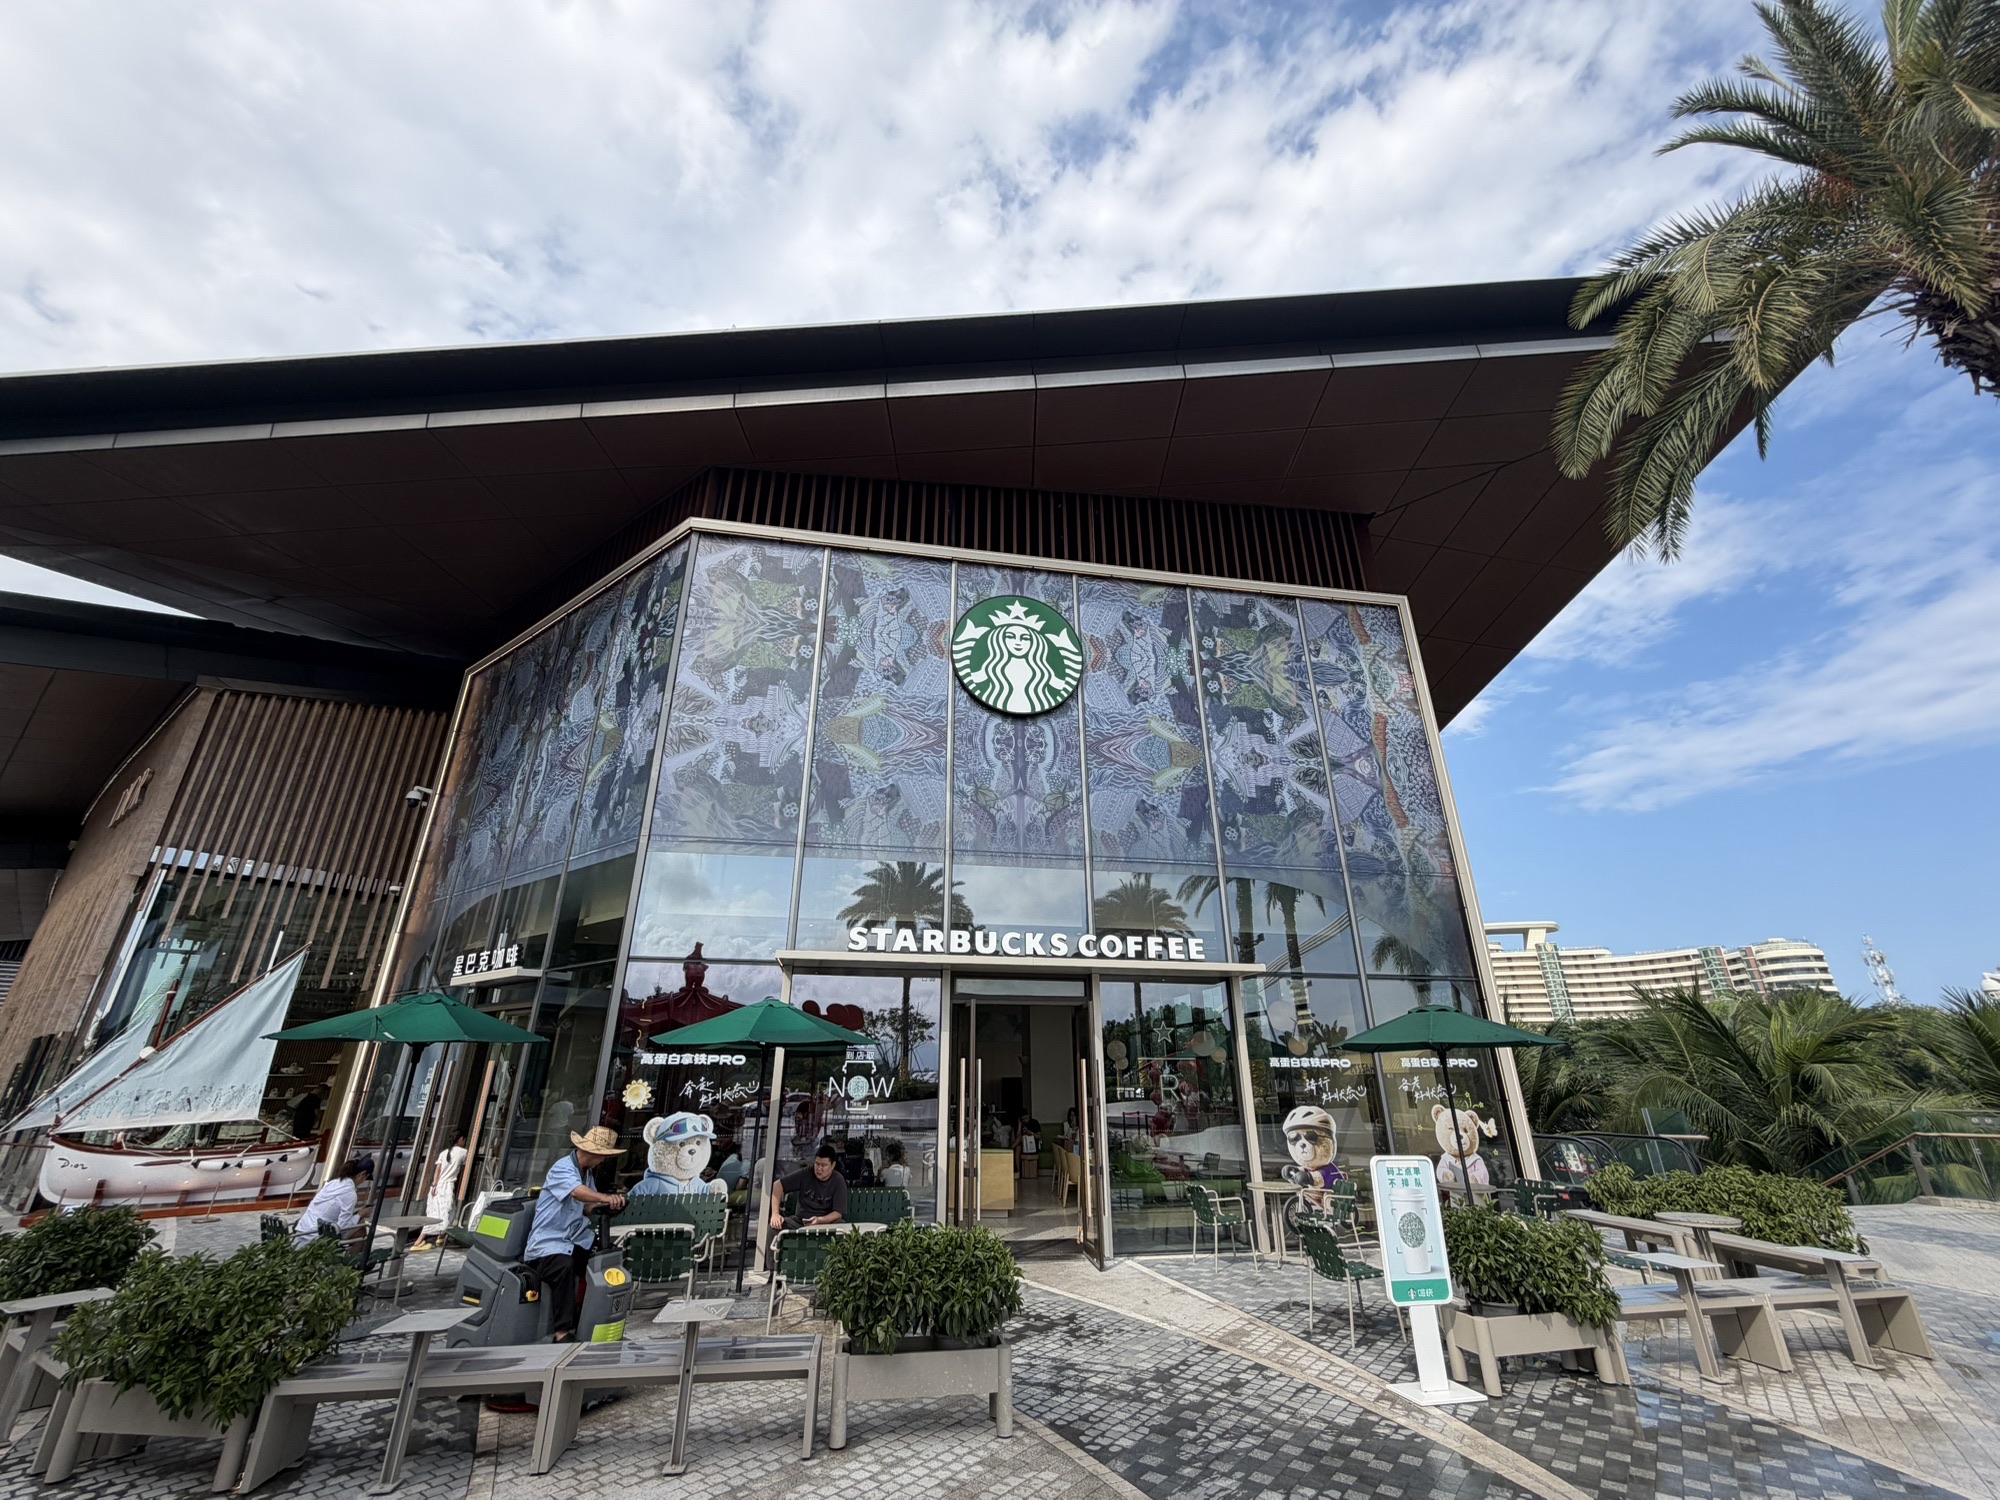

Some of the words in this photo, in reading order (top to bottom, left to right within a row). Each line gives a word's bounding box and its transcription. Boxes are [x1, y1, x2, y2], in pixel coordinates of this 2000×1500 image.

[848, 926, 1069, 957] STARBUCKS
[1077, 933, 1206, 961] COFFEE
[452, 943, 518, 976] 星巴克咖啡
[640, 1053, 746, 1065] 高蛋白拿铁PRO
[1269, 1057, 1351, 1068] 高蛋白拿铁PRO
[1401, 1057, 1478, 1068] 高蛋白拿PRO
[828, 1075, 896, 1098] NOW
[1160, 1074, 1181, 1101] R
[58, 1157, 88, 1170] Dior
[1386, 1166, 1421, 1177] 码上点单
[1388, 1177, 1423, 1189] 不排队
